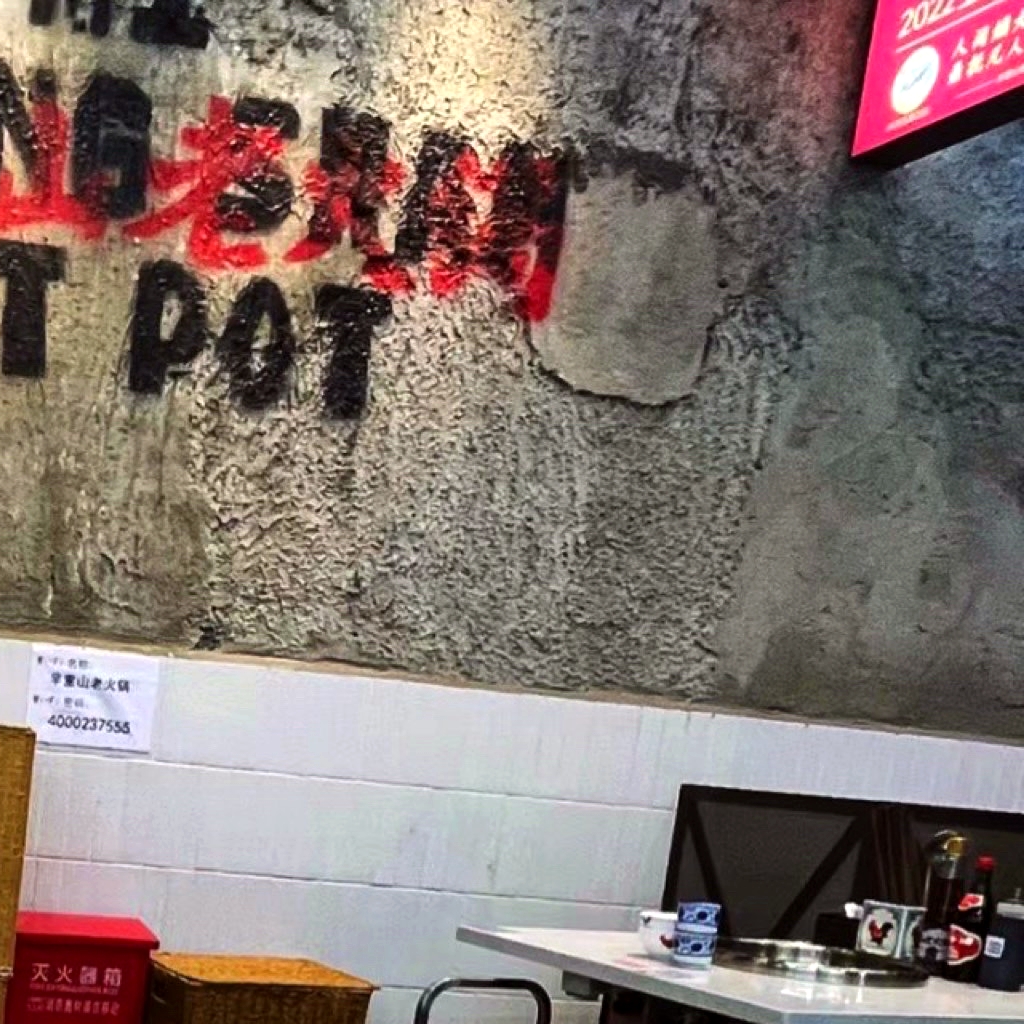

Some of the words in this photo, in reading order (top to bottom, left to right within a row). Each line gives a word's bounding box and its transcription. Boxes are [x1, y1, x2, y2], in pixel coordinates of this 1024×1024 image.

[127, 259, 392, 418] POT
[31, 963, 122, 987] 灭火器箱
